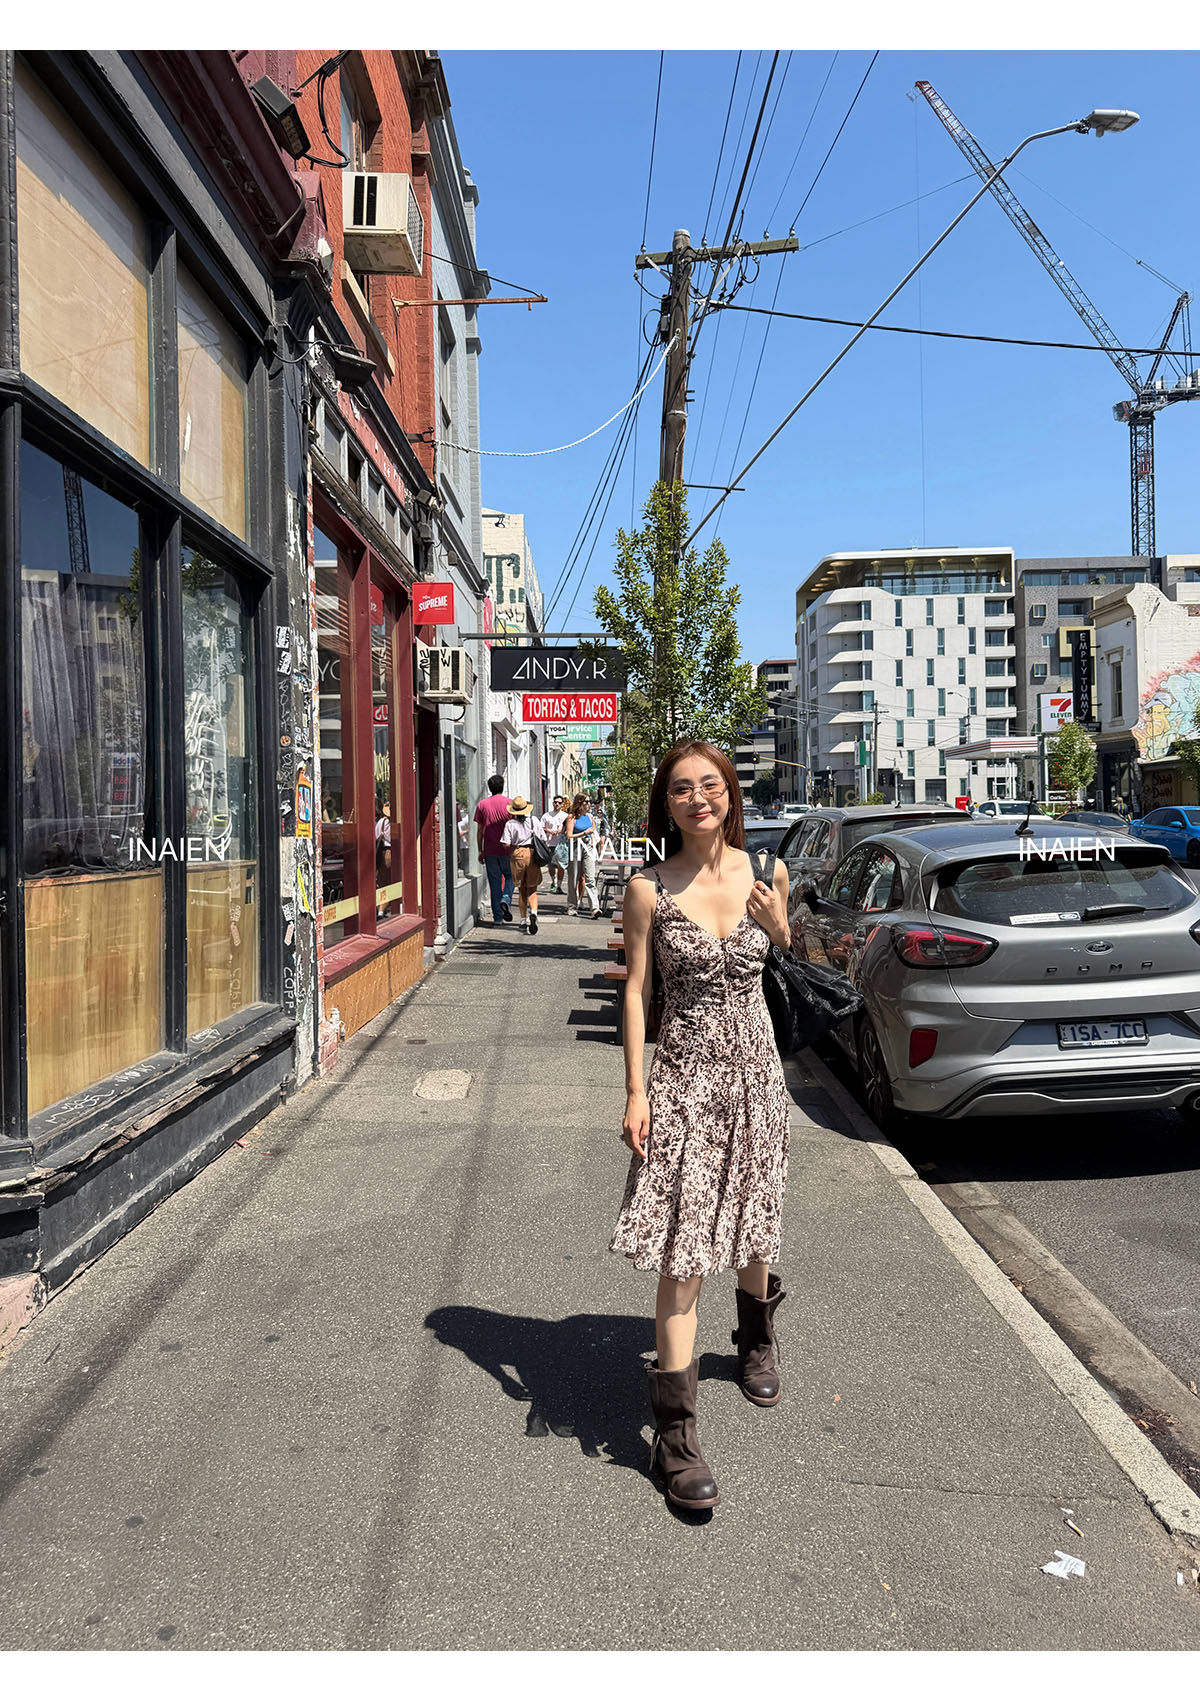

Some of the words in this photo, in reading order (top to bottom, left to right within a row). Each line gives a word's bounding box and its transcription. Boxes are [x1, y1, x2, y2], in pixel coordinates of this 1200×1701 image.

[419, 595, 448, 612] SUPREME
[527, 697, 568, 719] TORTAS
[569, 697, 577, 719] &
[578, 697, 613, 719] TACOS
[1046, 961, 1153, 977] PUMA
